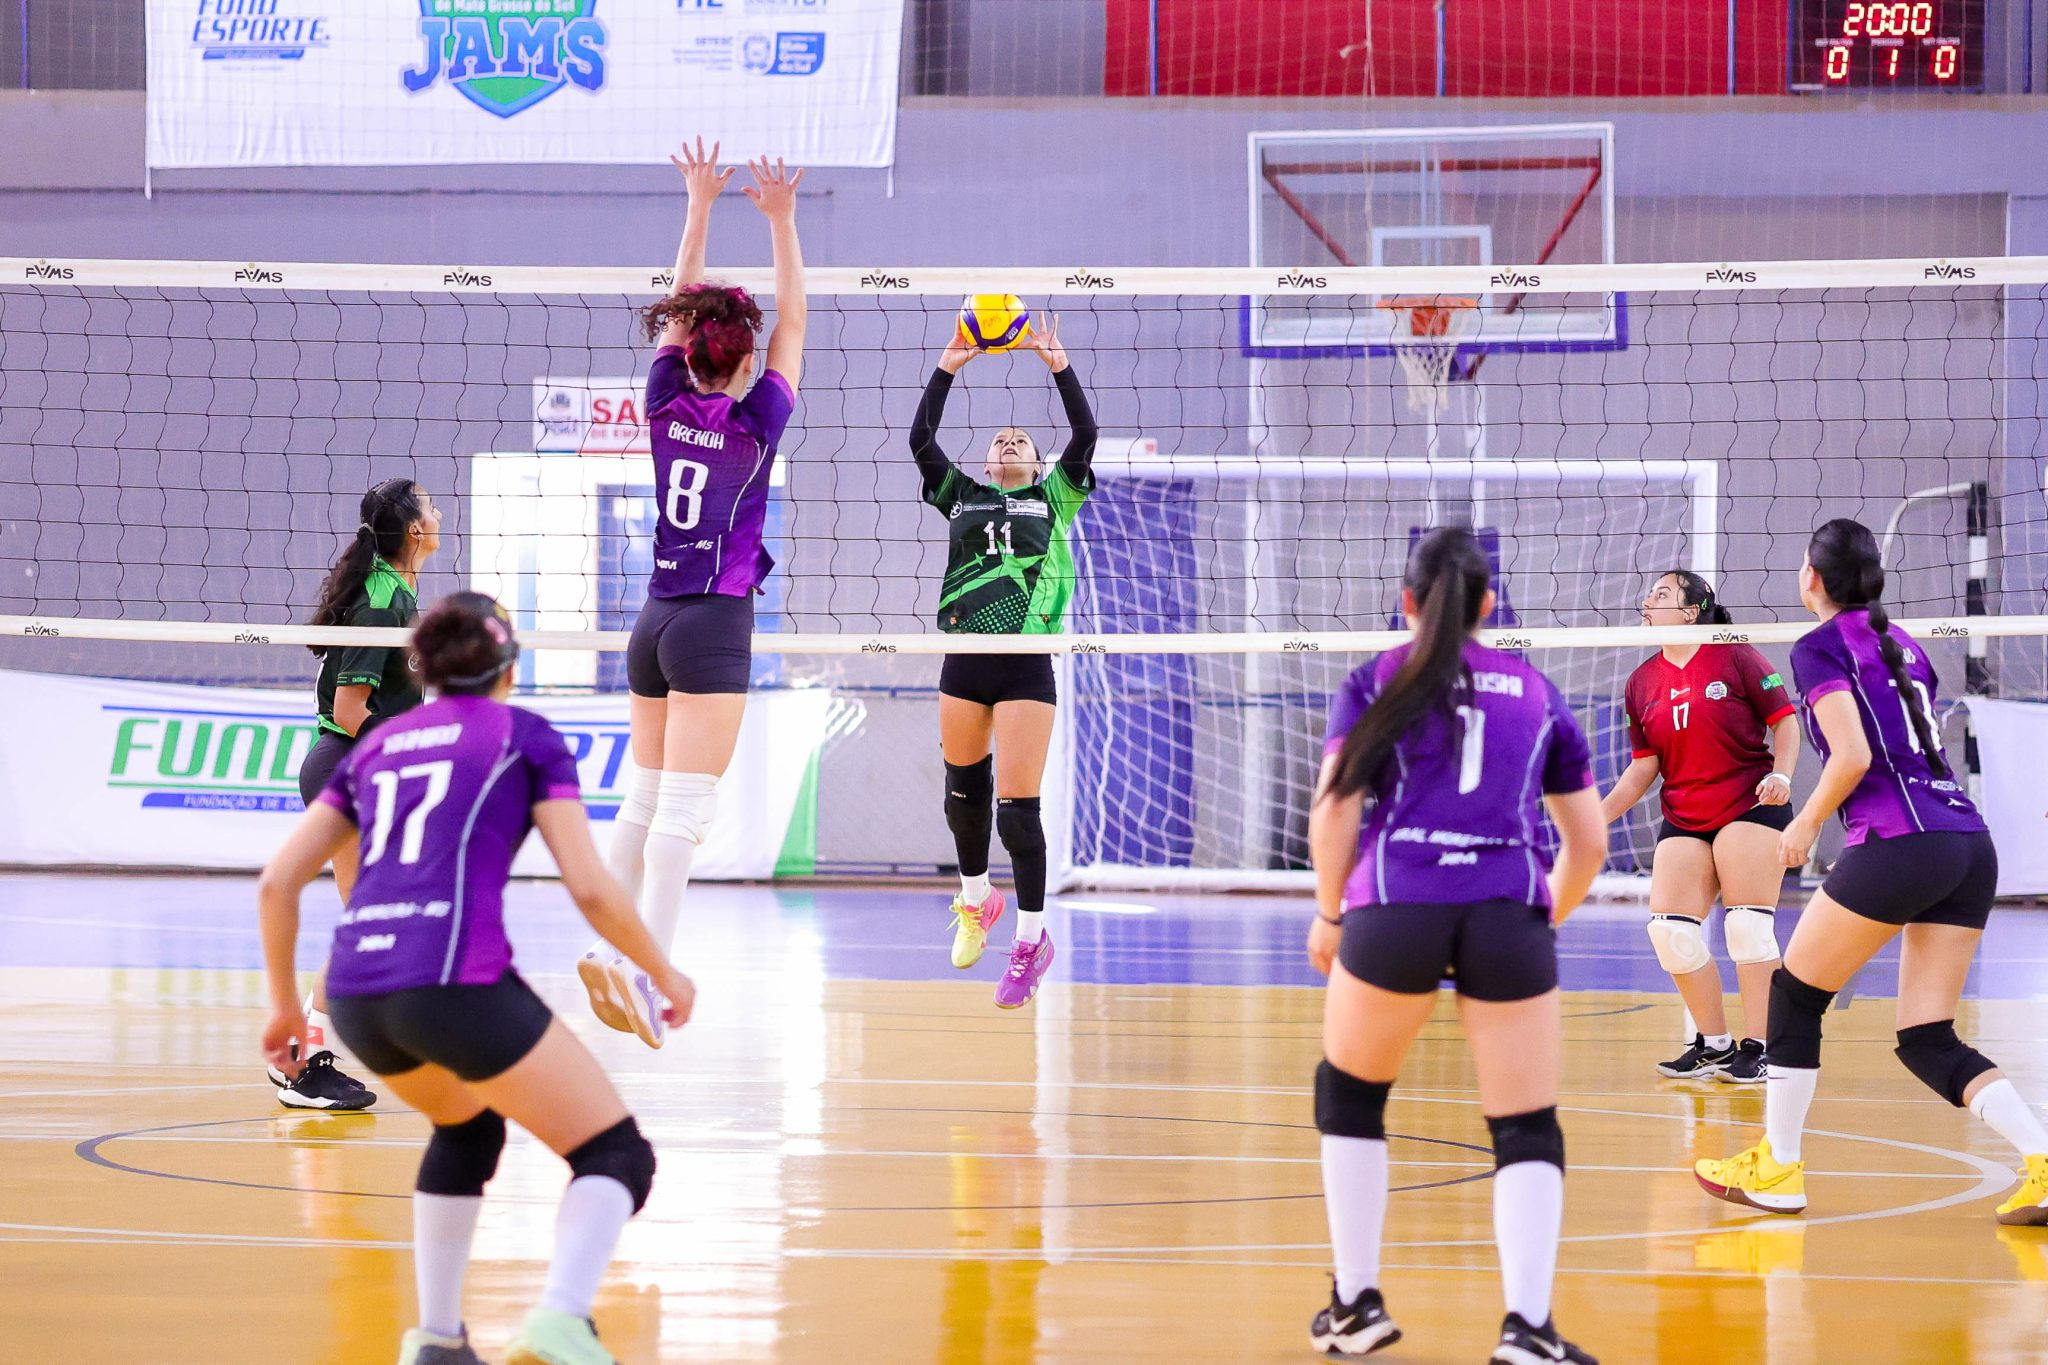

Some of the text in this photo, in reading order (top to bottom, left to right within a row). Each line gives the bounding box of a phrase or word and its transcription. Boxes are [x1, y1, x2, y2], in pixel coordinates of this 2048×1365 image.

[1843, 3, 1932, 36] 20:00
[402, 19, 607, 93] JAMS
[1827, 46, 1849, 79] 0
[1889, 49, 1899, 76] 1
[1934, 46, 1956, 78] 0
[652, 275, 674, 287] FV
[666, 459, 709, 530] 8
[695, 540, 714, 550] MS
[983, 521, 1014, 555] 11
[1672, 702, 1690, 731] 17
[110, 718, 320, 781] FUND
[1456, 705, 1486, 794] 1
[363, 760, 453, 866] 17
